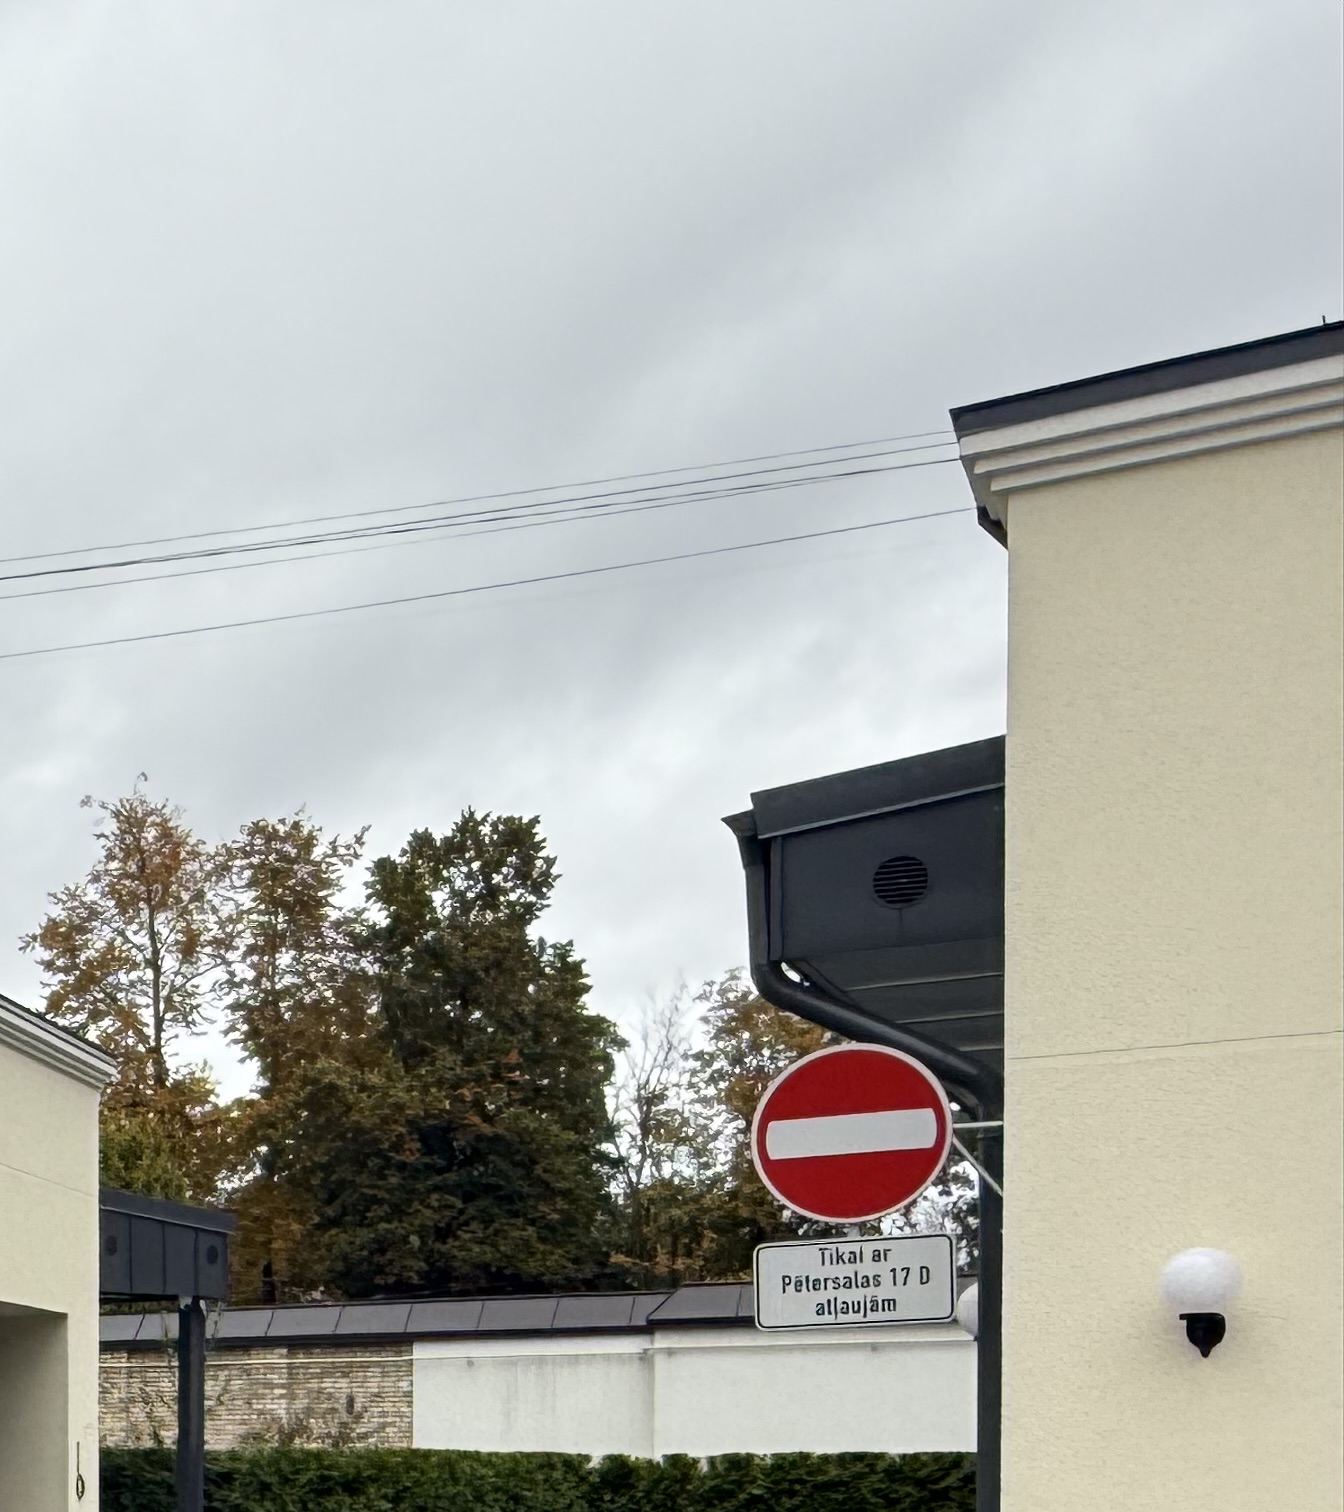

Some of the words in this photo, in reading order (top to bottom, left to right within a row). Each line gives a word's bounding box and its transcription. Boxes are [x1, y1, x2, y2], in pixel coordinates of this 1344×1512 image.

[818, 1245, 864, 1266] Tikai
[871, 1248, 892, 1262] ar
[781, 1270, 882, 1294] Pētersalas
[889, 1266, 910, 1287] 17
[919, 1265, 931, 1285] D
